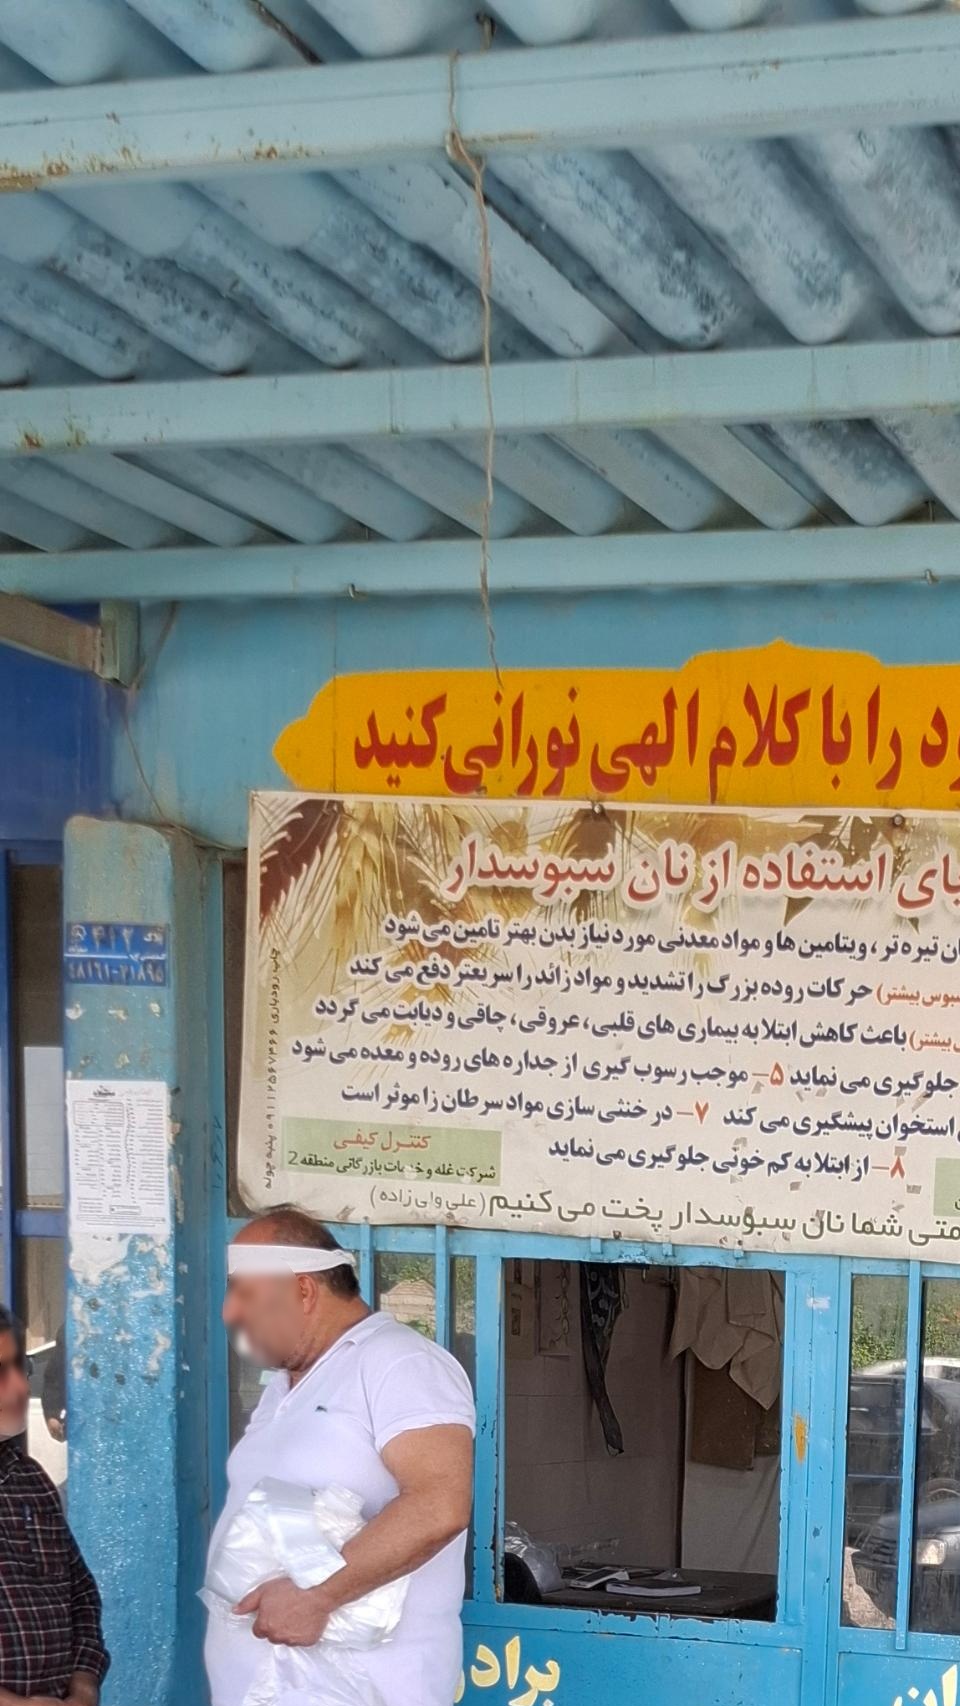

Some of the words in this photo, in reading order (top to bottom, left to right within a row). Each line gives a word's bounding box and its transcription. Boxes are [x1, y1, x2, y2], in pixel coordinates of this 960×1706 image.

[354, 692, 448, 789] کنید
[441, 687, 582, 798] نورانی
[590, 686, 699, 794] الهی
[709, 683, 812, 803] کلام
[820, 684, 852, 790] با
[867, 684, 902, 790] را
[447, 840, 616, 897] سبوسدار
[627, 844, 689, 902] نان
[701, 849, 731, 905] از
[743, 848, 886, 897] استفاده
[453, 919, 500, 943] تامین
[505, 922, 537, 946] بهتر
[538, 926, 576, 948] بدن
[577, 923, 610, 949] نیاز
[611, 928, 656, 953] مورد
[657, 926, 719, 954] معدنی
[721, 929, 761, 957] مواد
[762, 939, 774, 958] و
[797, 931, 867, 962] ویتامین
[901, 937, 939, 963] تیره
[416, 956, 451, 985] دفع
[453, 966, 513, 988] سریعتر
[516, 963, 533, 991] را
[534, 965, 571, 993] زائد
[573, 966, 613, 994] مواد
[627, 971, 686, 996] تشدید
[614, 976, 625, 996] و
[687, 972, 704, 1000] را
[706, 974, 759, 1002] بزرگ
[760, 979, 804, 1004] روده
[806, 976, 873, 1006] حرکات
[876, 985, 921, 1006] بیشتر)
[393, 1000, 442, 1027] دیابت
[444, 1011, 456, 1029] و
[457, 1002, 507, 1033] چاقی
[677, 1016, 739, 1044] بیماری
[741, 1023, 759, 1045] به
[761, 1018, 798, 1047] ابتلا
[799, 1021, 859, 1049] کاهش
[860, 1024, 907, 1052] باعث
[908, 1034, 952, 1053] بیشتر)
[360, 1045, 405, 1062] معده
[406, 1051, 417, 1069] و
[419, 1048, 461, 1072] روده
[502, 1049, 558, 1077] جداره
[561, 1052, 578, 1079] از
[582, 1055, 631, 1081] گیری
[633, 1063, 688, 1086] رسوب
[690, 1066, 748, 1089] موجب
[341, 1083, 380, 1102] است
[382, 1082, 420, 1111] موثر
[873, 1070, 959, 1099] جلوگیری
[422, 1086, 439, 1113] زا
[441, 1088, 504, 1116] سرطان
[506, 1091, 544, 1119] مواد
[546, 1095, 595, 1121] سازی
[597, 1098, 648, 1124] خنثی
[650, 1105, 673, 1127] در
[792, 1110, 873, 1140] پیشگیری
[875, 1113, 955, 1141] استخوان
[627, 1144, 710, 1172] جلوگیری
[712, 1147, 765, 1176] خونی
[767, 1151, 793, 1177] کم
[794, 1156, 812, 1177] به
[814, 1151, 850, 1180] ابتلا
[851, 1155, 869, 1182] از
[601, 1197, 664, 1232] پخت
[668, 1202, 797, 1237] سبوسدار
[801, 1210, 845, 1240] نان
[850, 1209, 902, 1239] شما
